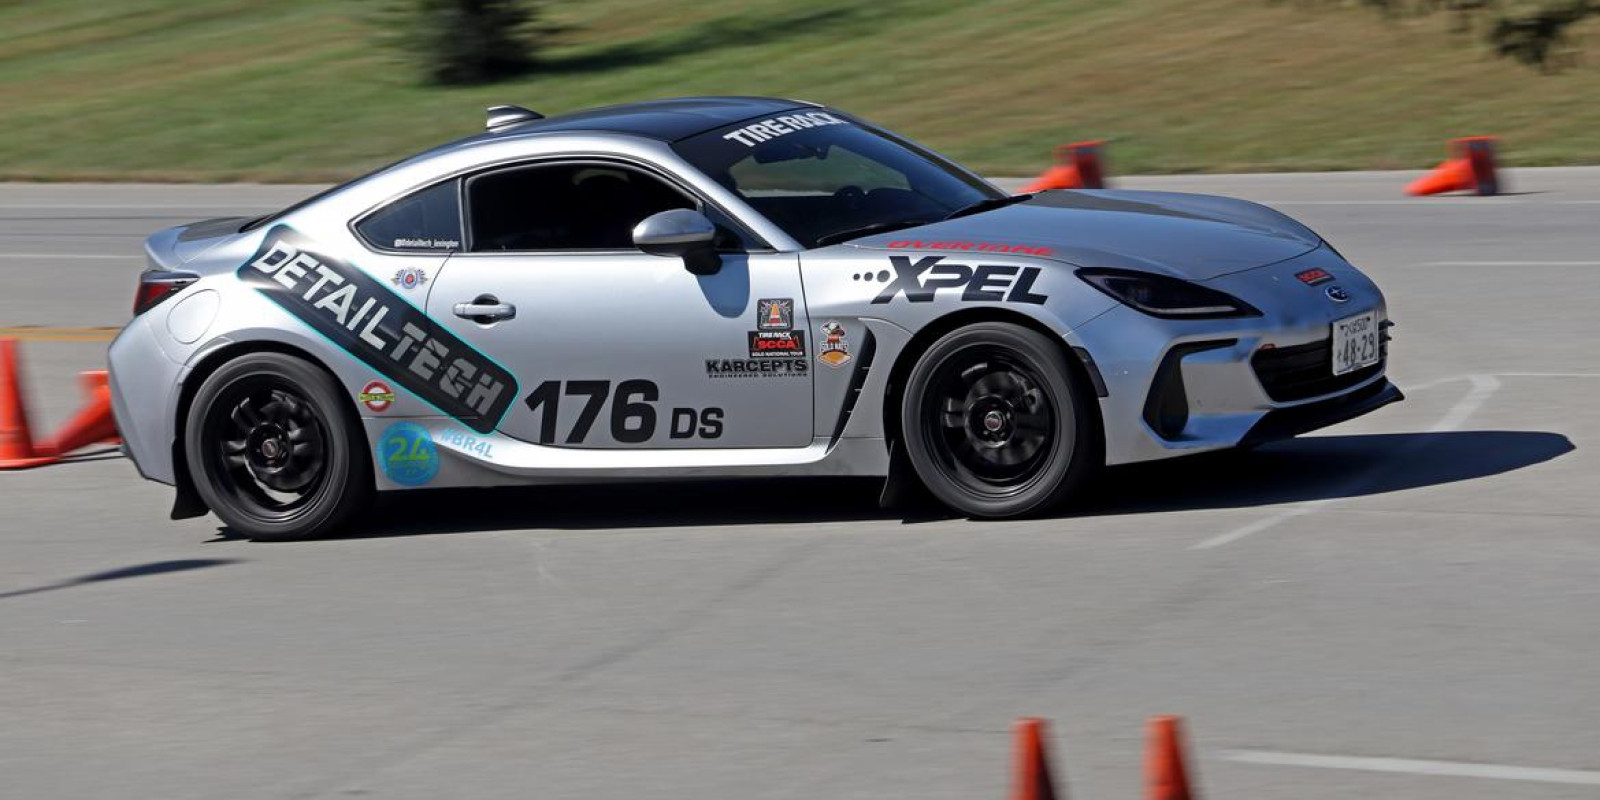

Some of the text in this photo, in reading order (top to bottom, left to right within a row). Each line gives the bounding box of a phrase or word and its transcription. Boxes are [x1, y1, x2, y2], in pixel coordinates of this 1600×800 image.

[722, 119, 795, 147] TIRE
[870, 255, 1049, 305] XPEL
[757, 340, 796, 349] SCCA
[705, 359, 808, 373] KARCEPTS
[525, 379, 724, 445] 176 DS
[441, 428, 493, 458] #BR4L
